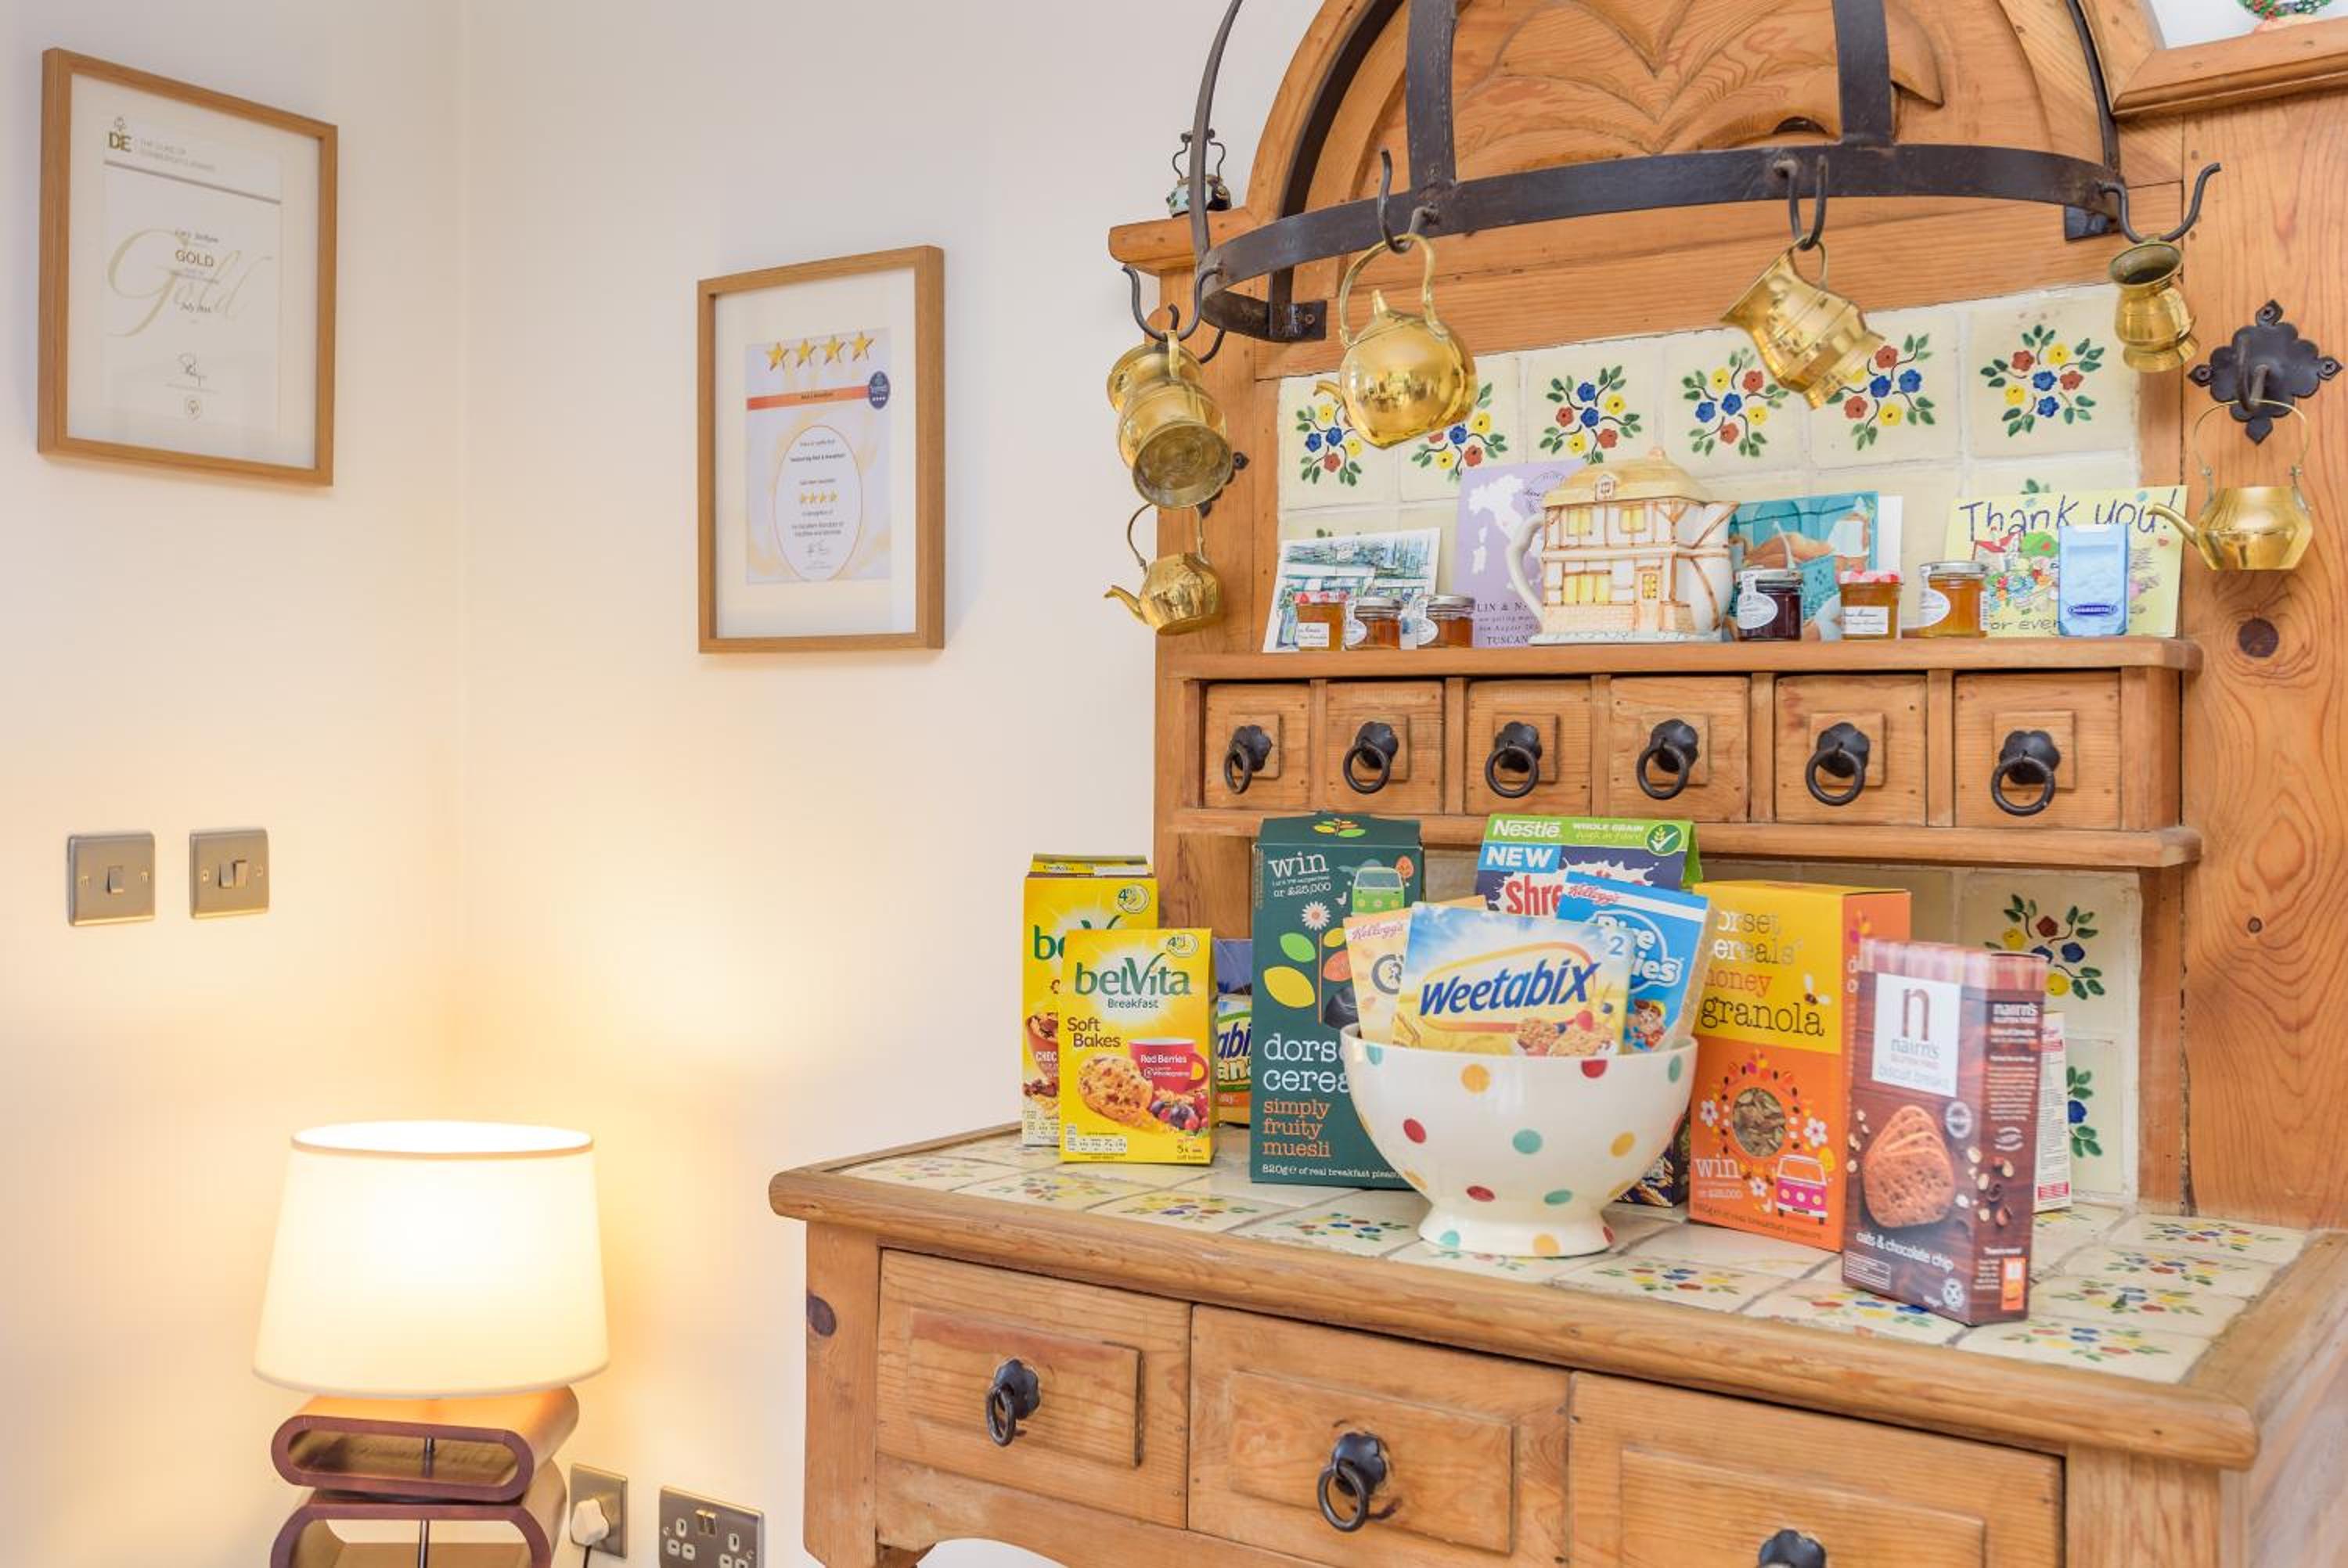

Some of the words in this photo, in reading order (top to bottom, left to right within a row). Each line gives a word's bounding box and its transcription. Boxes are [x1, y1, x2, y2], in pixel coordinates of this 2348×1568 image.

[175, 249, 214, 267] GOLD
[1959, 494, 2079, 541] Thank
[1267, 851, 1330, 878] win
[1487, 846, 1553, 869] NEW
[1505, 874, 1563, 916] Shre
[1716, 910, 1782, 936] orset
[1713, 937, 1795, 966] ereals
[1075, 952, 1192, 996] belVita
[1419, 959, 1602, 1016] Weetabix
[1107, 998, 1159, 1009] Breakfast
[1067, 1016, 1100, 1031] Soft
[1701, 996, 1825, 1037] granola
[1073, 1032, 1121, 1048] Bakes
[1264, 1033, 1337, 1063] dors
[1891, 1038, 1940, 1059] nairn's
[1140, 1055, 1157, 1063] Red
[1158, 1055, 1187, 1063] Berries
[1262, 1098, 1331, 1120] simply
[1262, 1117, 1323, 1140] fruity
[1262, 1141, 1331, 1158] muesli
[1328, 1168, 1370, 1178] breakfast
[1694, 1153, 1741, 1178] win
[1856, 1232, 1876, 1246] oats
[1885, 1239, 1930, 1264] chocolate
[1931, 1253, 1954, 1273] chip
